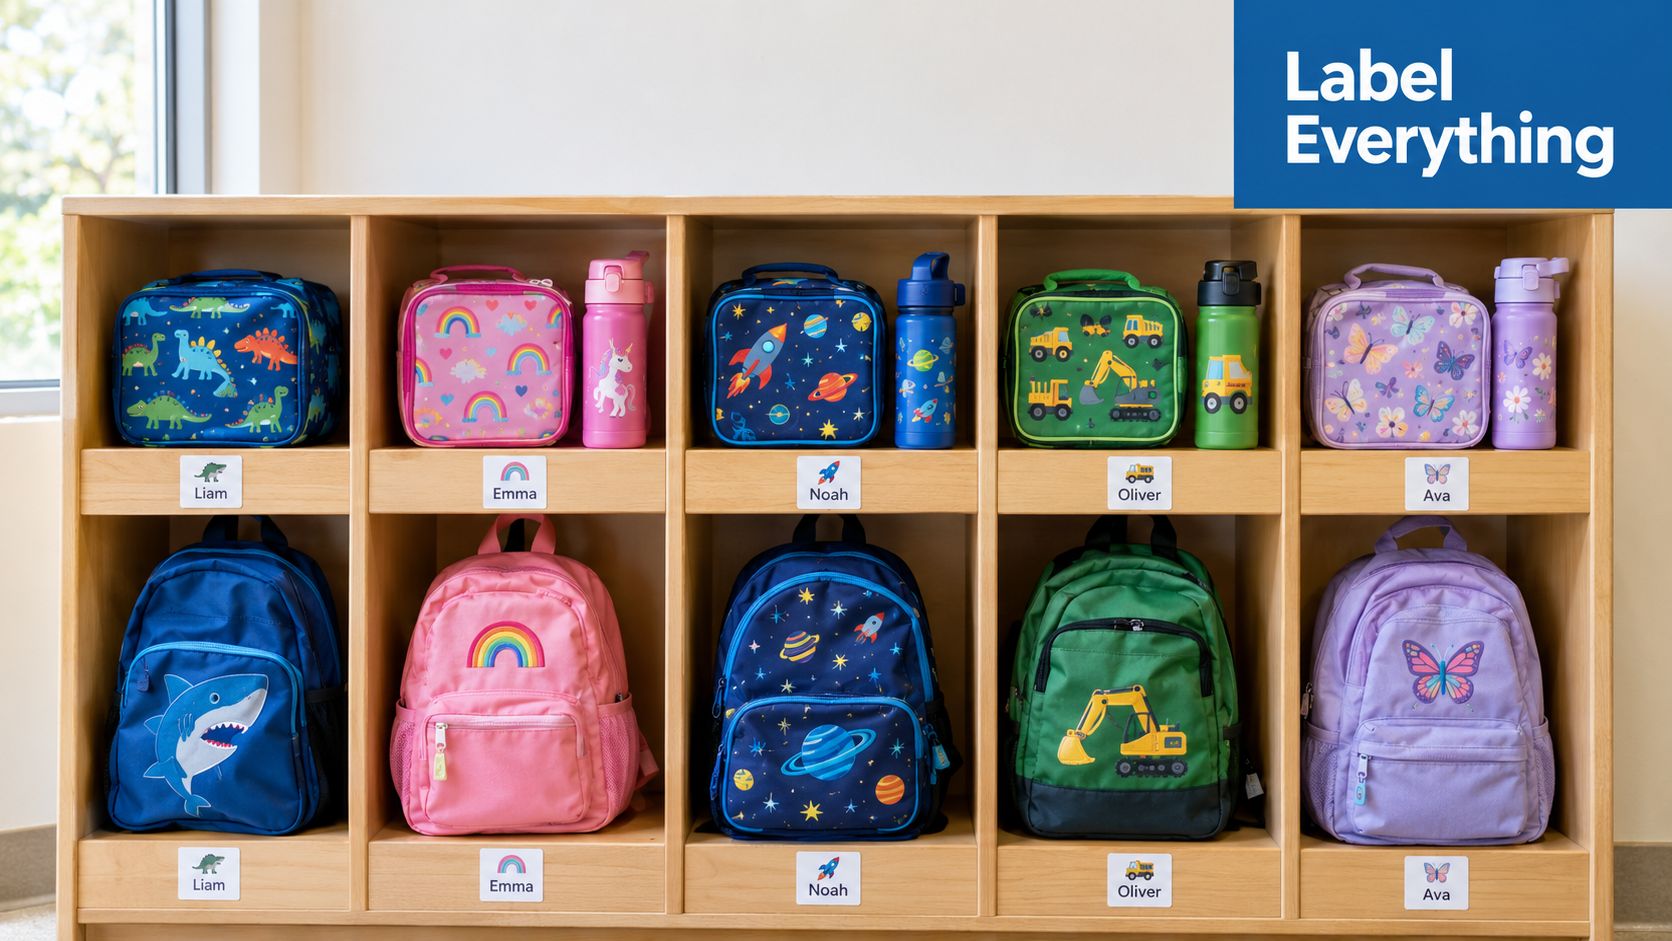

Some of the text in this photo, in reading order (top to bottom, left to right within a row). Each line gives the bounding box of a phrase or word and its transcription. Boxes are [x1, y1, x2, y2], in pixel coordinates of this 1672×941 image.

[195, 486, 228, 500] Liam
[493, 487, 537, 500] Emma
[809, 487, 849, 501] Noah
[1118, 488, 1162, 502] Oliver
[1423, 488, 1451, 502] Ava
[193, 878, 225, 891] Liam
[490, 879, 534, 893] Emma
[808, 883, 848, 897] Noah
[1117, 884, 1162, 898] Oliver
[1422, 888, 1451, 901] Ava
